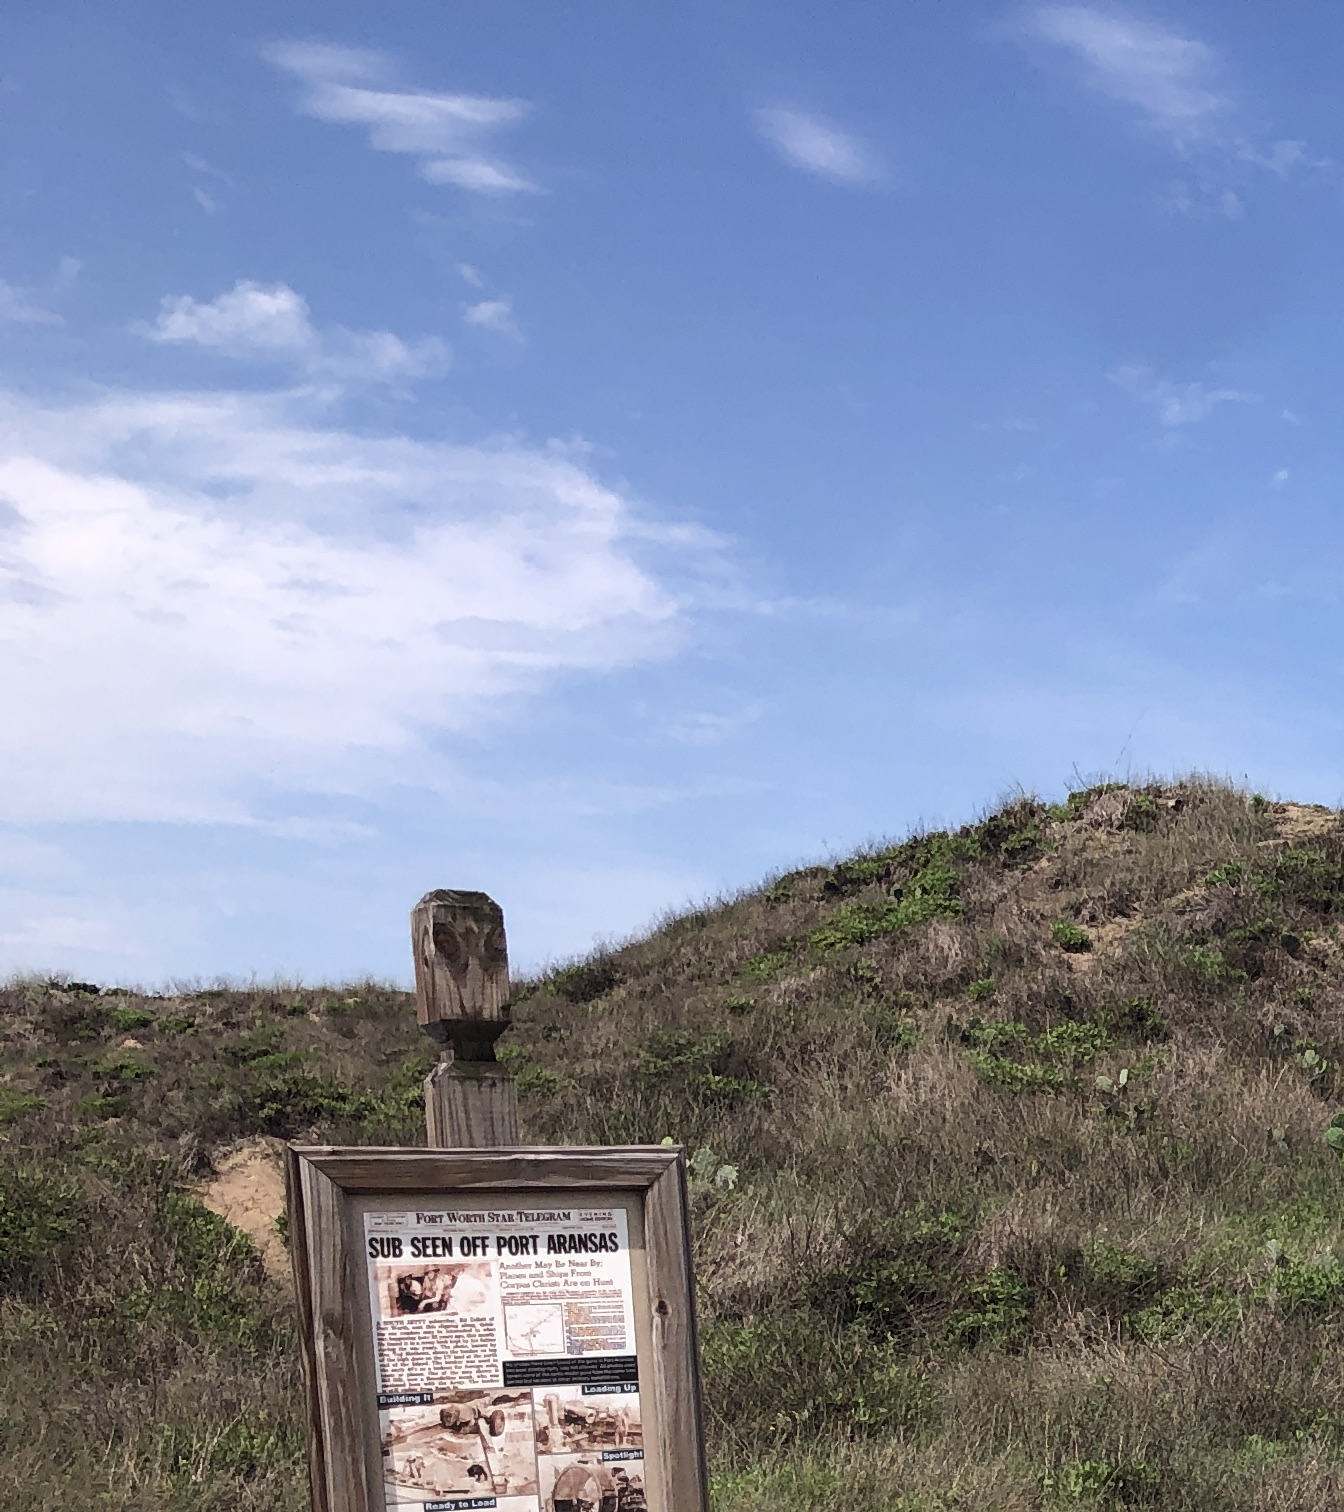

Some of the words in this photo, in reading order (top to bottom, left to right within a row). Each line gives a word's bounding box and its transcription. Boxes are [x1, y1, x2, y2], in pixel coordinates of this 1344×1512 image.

[416, 1213, 444, 1224] FORT
[447, 1212, 485, 1223] WORTH
[369, 1237, 403, 1258] SUB
[411, 1236, 453, 1257] SEEN
[460, 1236, 490, 1257] OFF
[496, 1235, 539, 1256] PORT
[547, 1233, 618, 1254] ARANSAS
[535, 1261, 552, 1269] May
[555, 1260, 565, 1268] Be
[585, 1385, 621, 1393] Loading
[624, 1384, 636, 1392] Up
[380, 1395, 420, 1403] Building
[604, 1451, 642, 1460] Spotlight
[426, 1502, 455, 1510] Ready
[472, 1499, 495, 1507] Load
